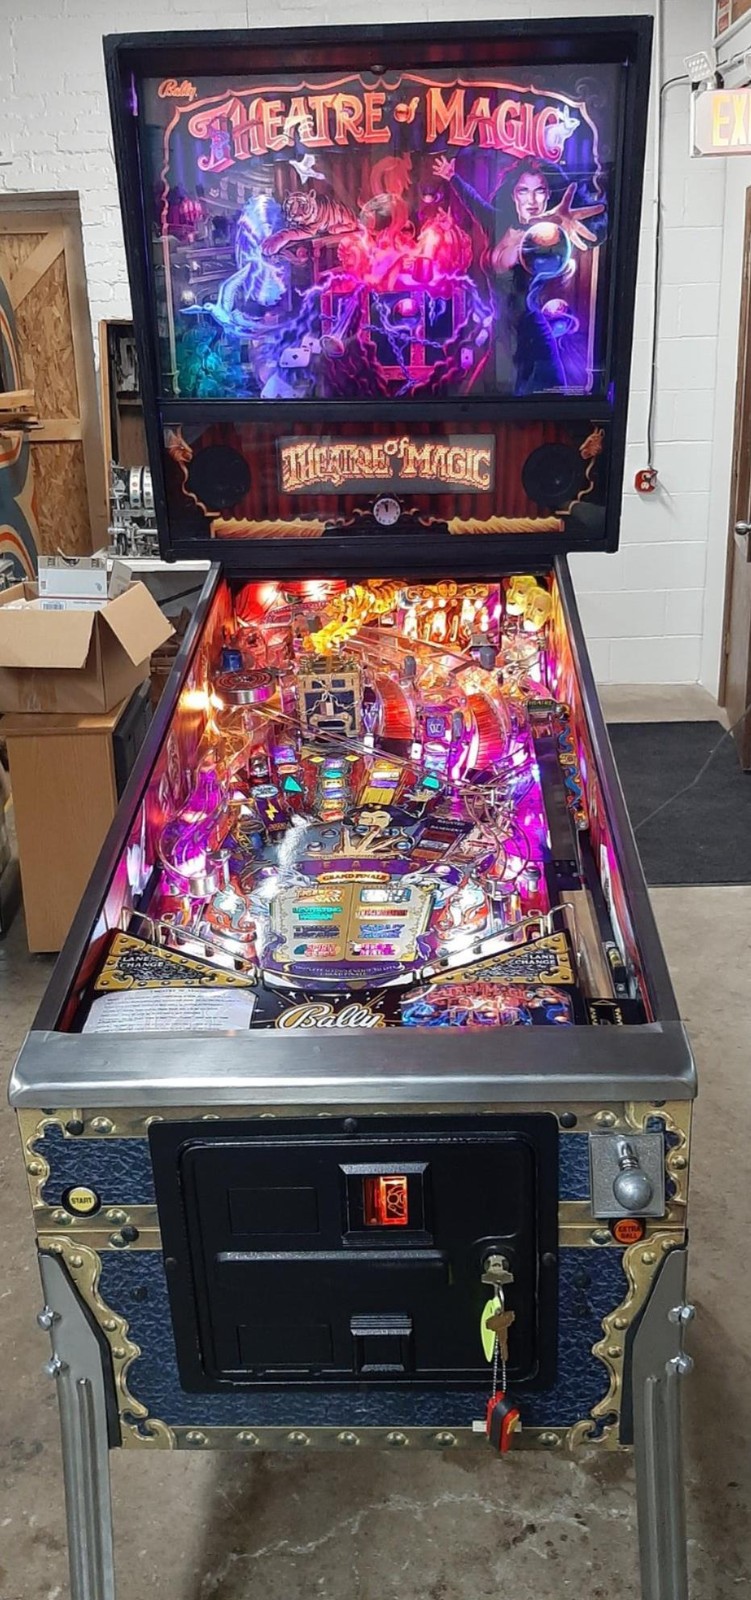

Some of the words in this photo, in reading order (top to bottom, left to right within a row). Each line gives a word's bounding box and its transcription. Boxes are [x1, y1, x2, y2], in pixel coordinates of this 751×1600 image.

[188, 92, 391, 173] THEATRE
[426, 88, 563, 163] MAGIC
[282, 443, 393, 492] THEATRE
[399, 443, 490, 490] MAGIC
[276, 1003, 385, 1028] Bally
